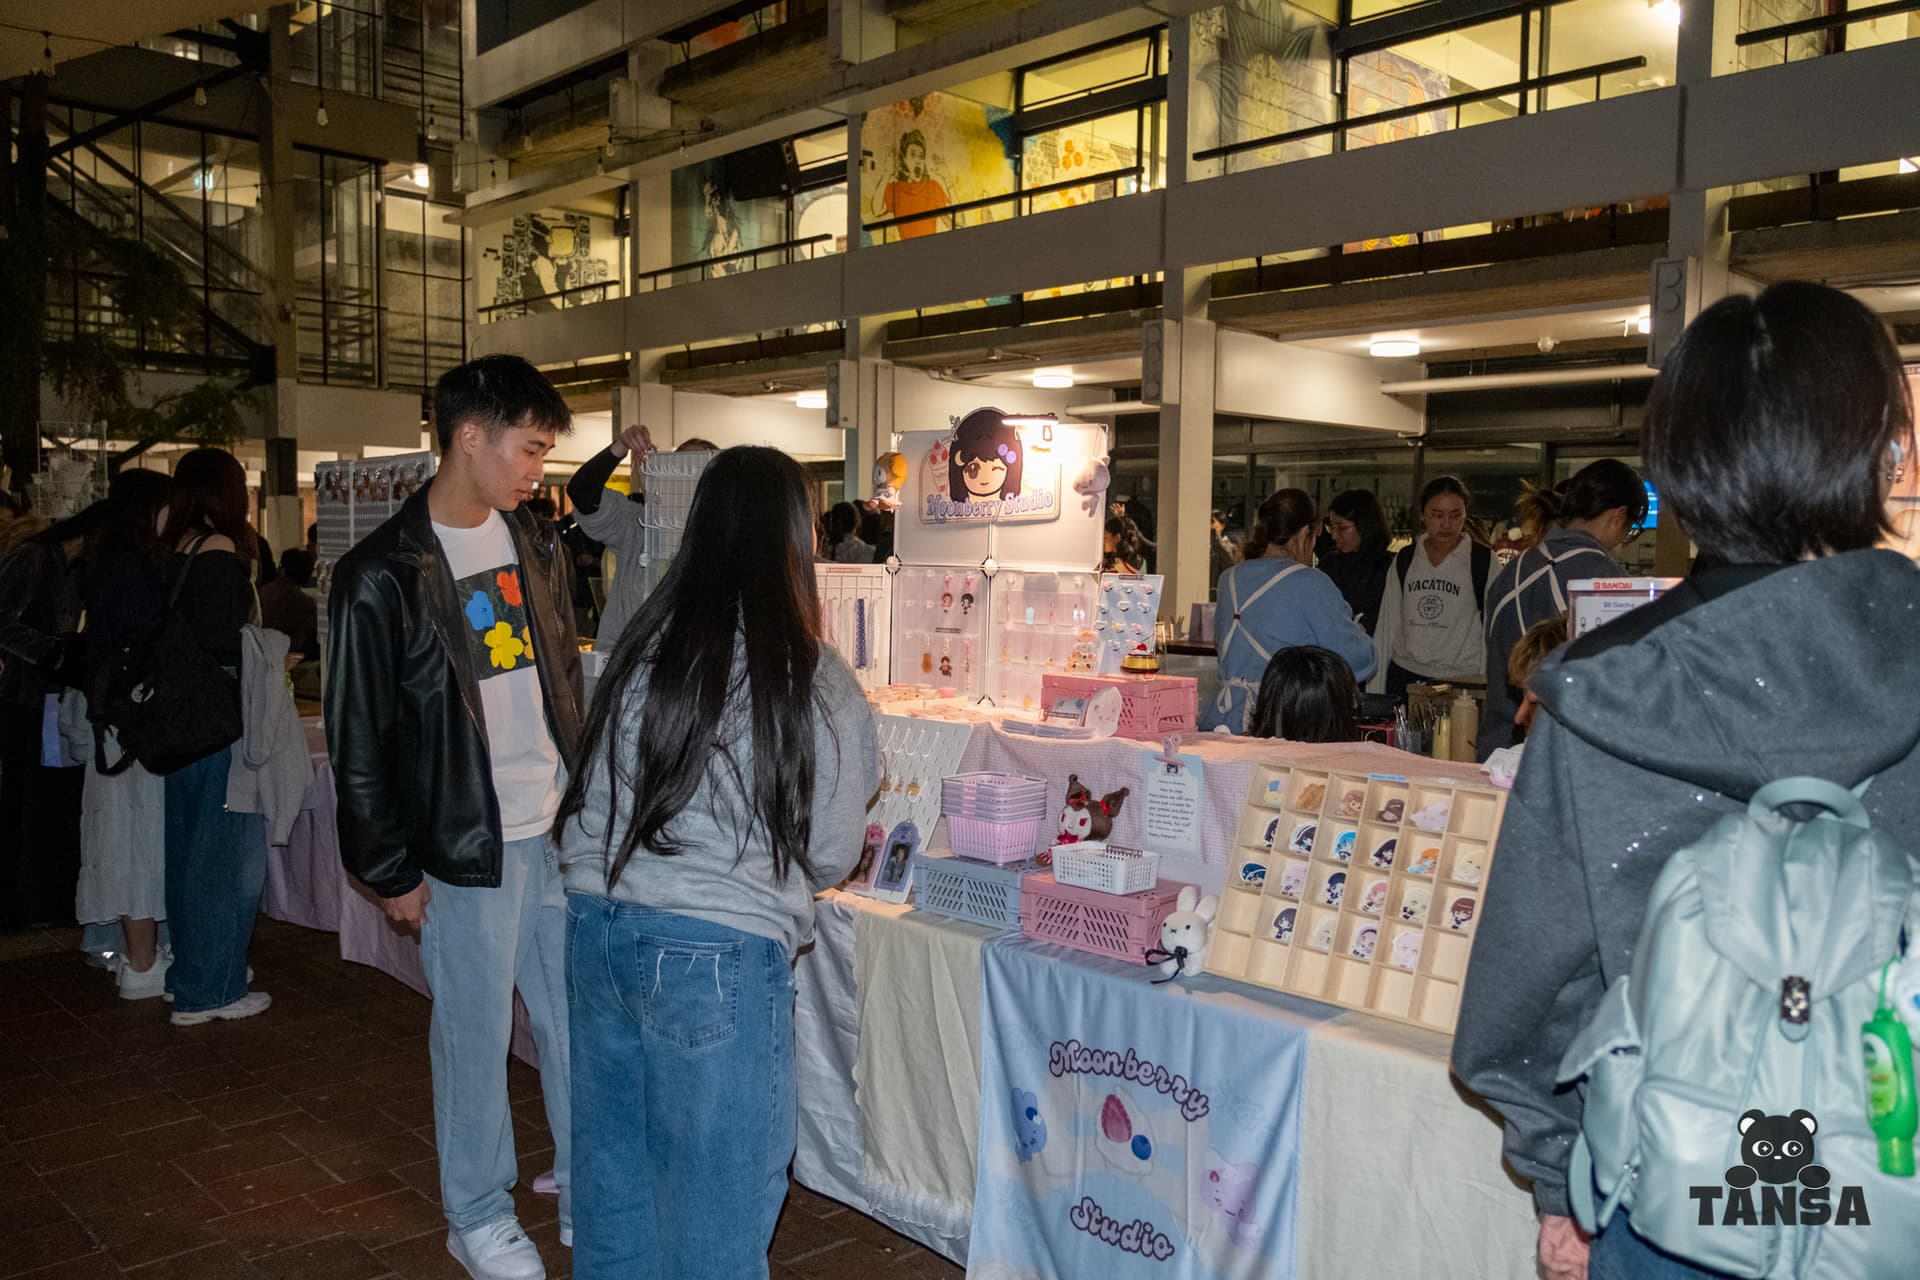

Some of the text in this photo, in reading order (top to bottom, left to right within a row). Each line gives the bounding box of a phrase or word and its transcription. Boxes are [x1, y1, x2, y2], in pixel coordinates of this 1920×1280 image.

[926, 491, 1053, 524] Moonberry Studio
[1408, 579, 1461, 596] VACATION
[1049, 1039, 1210, 1122] Moonberry
[1070, 1196, 1175, 1261] Studio
